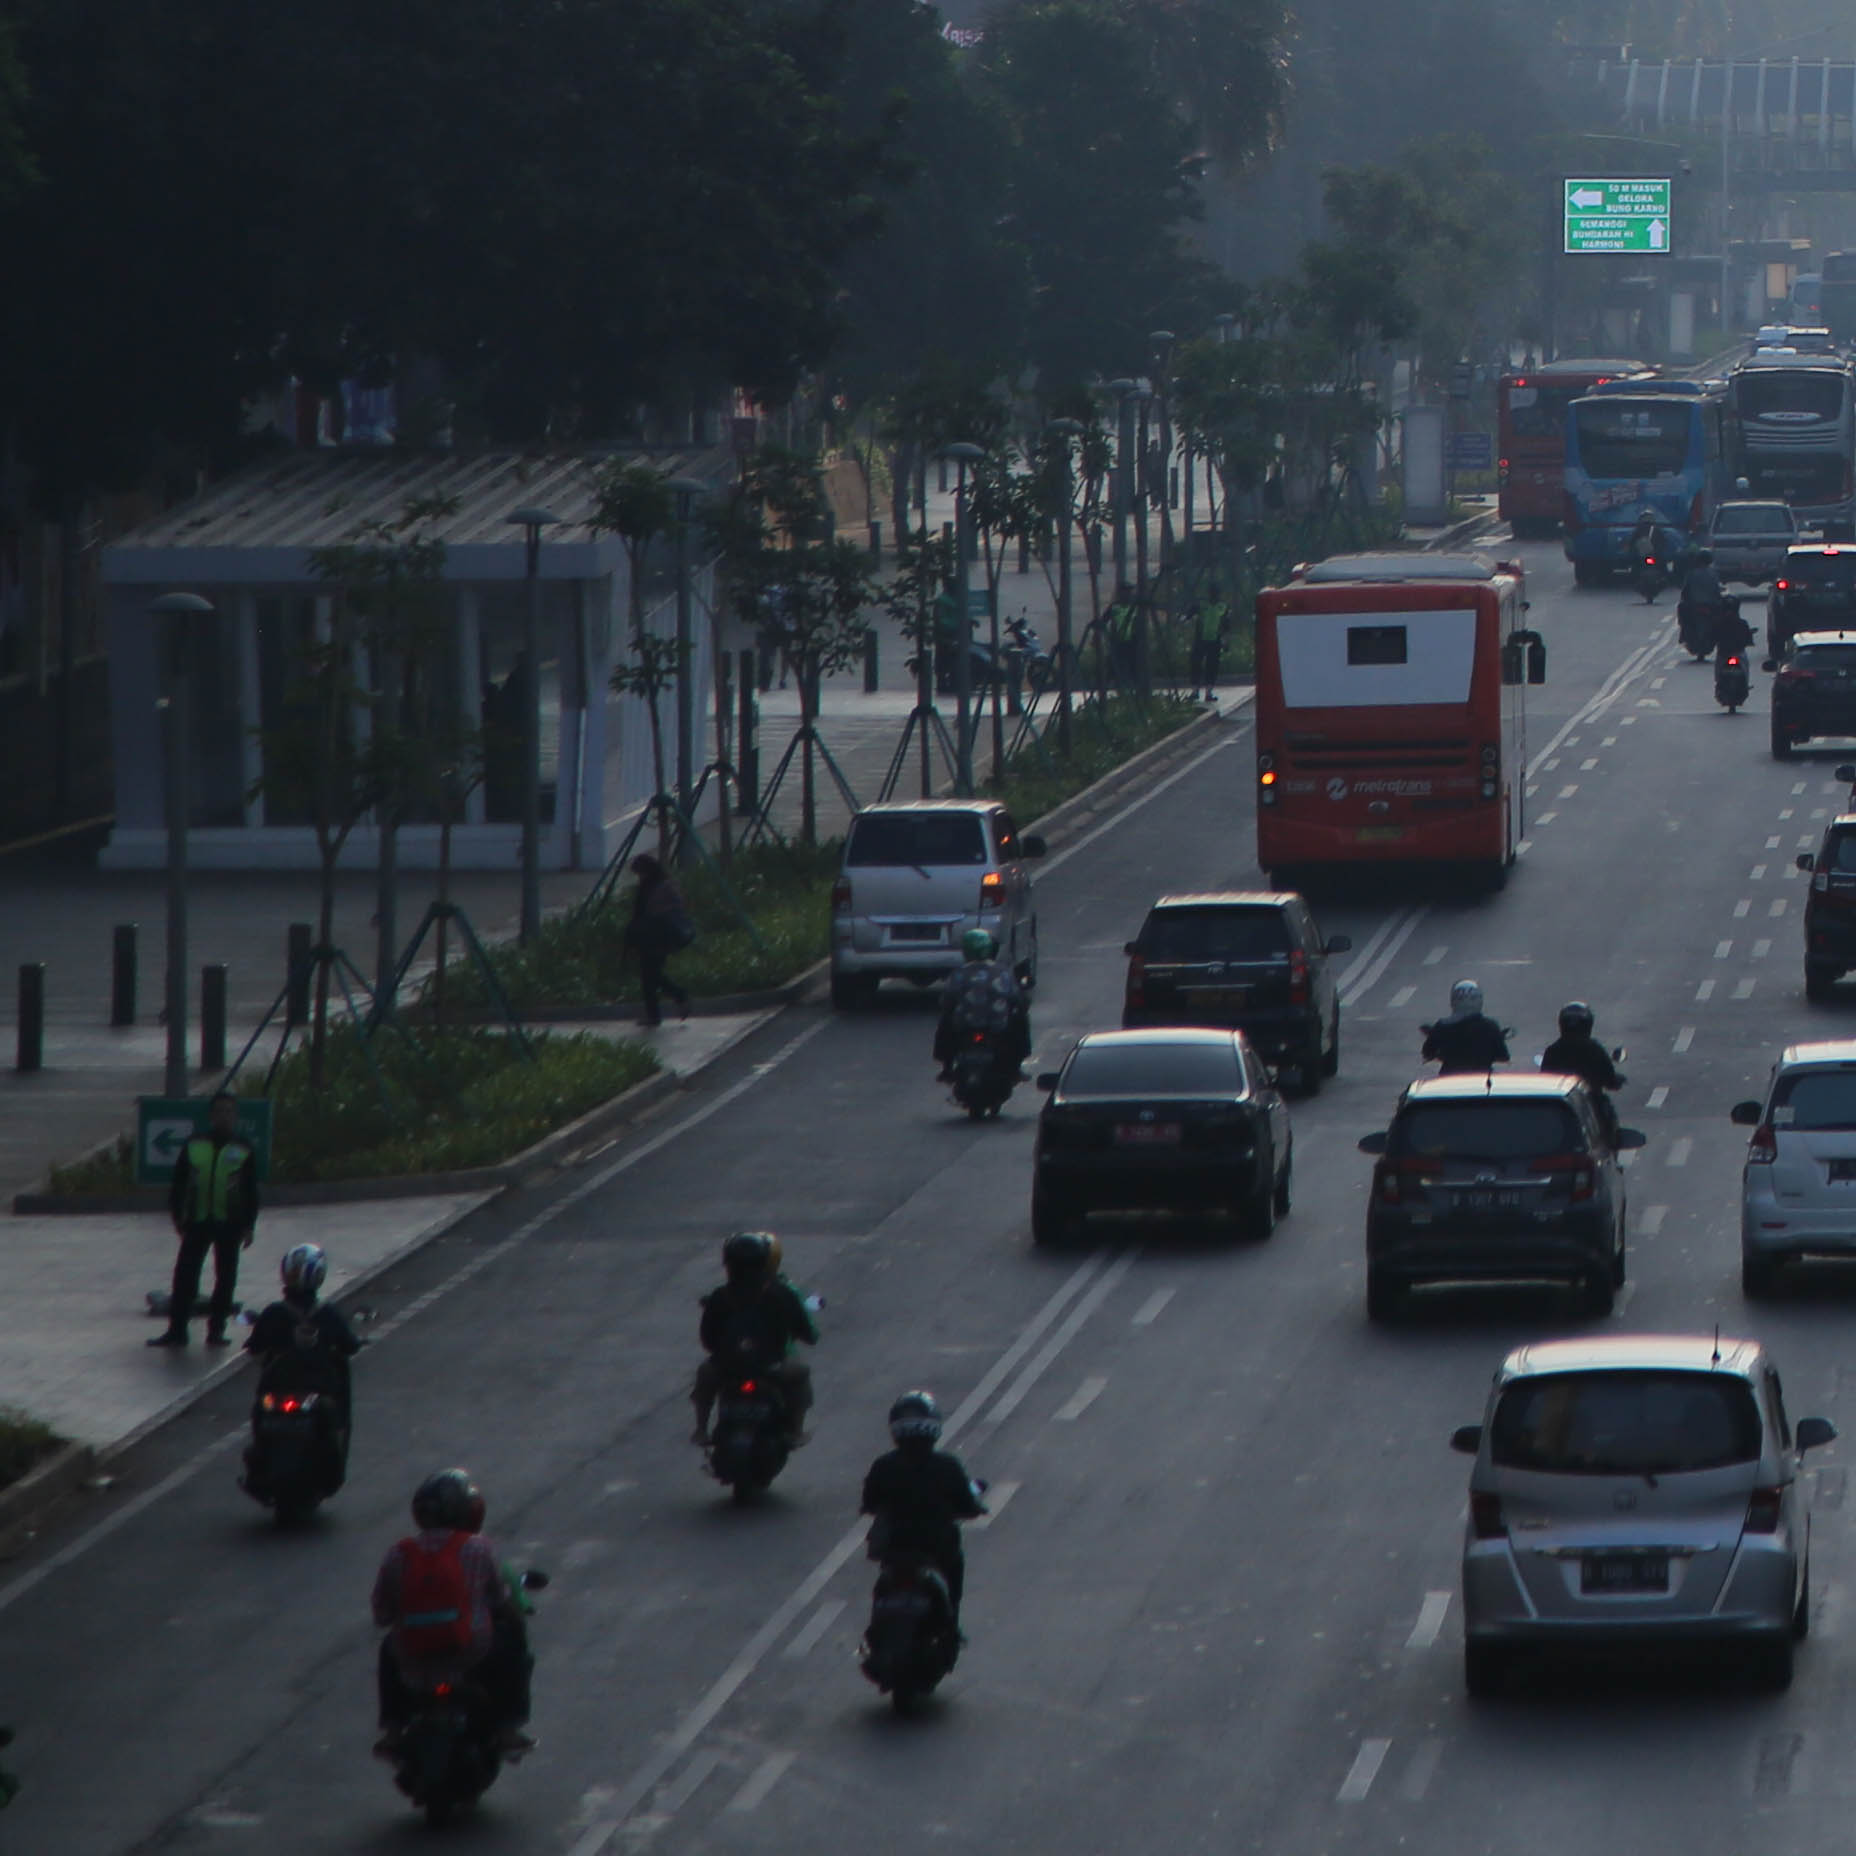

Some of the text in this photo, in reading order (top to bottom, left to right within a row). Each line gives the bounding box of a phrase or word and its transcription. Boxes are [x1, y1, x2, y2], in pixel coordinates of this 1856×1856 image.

[1631, 184, 1664, 193] MASUK
[1618, 194, 1653, 203] GELORA
[1606, 204, 1665, 213] BUNG KARNO
[1582, 240, 1625, 249] HARMONI
